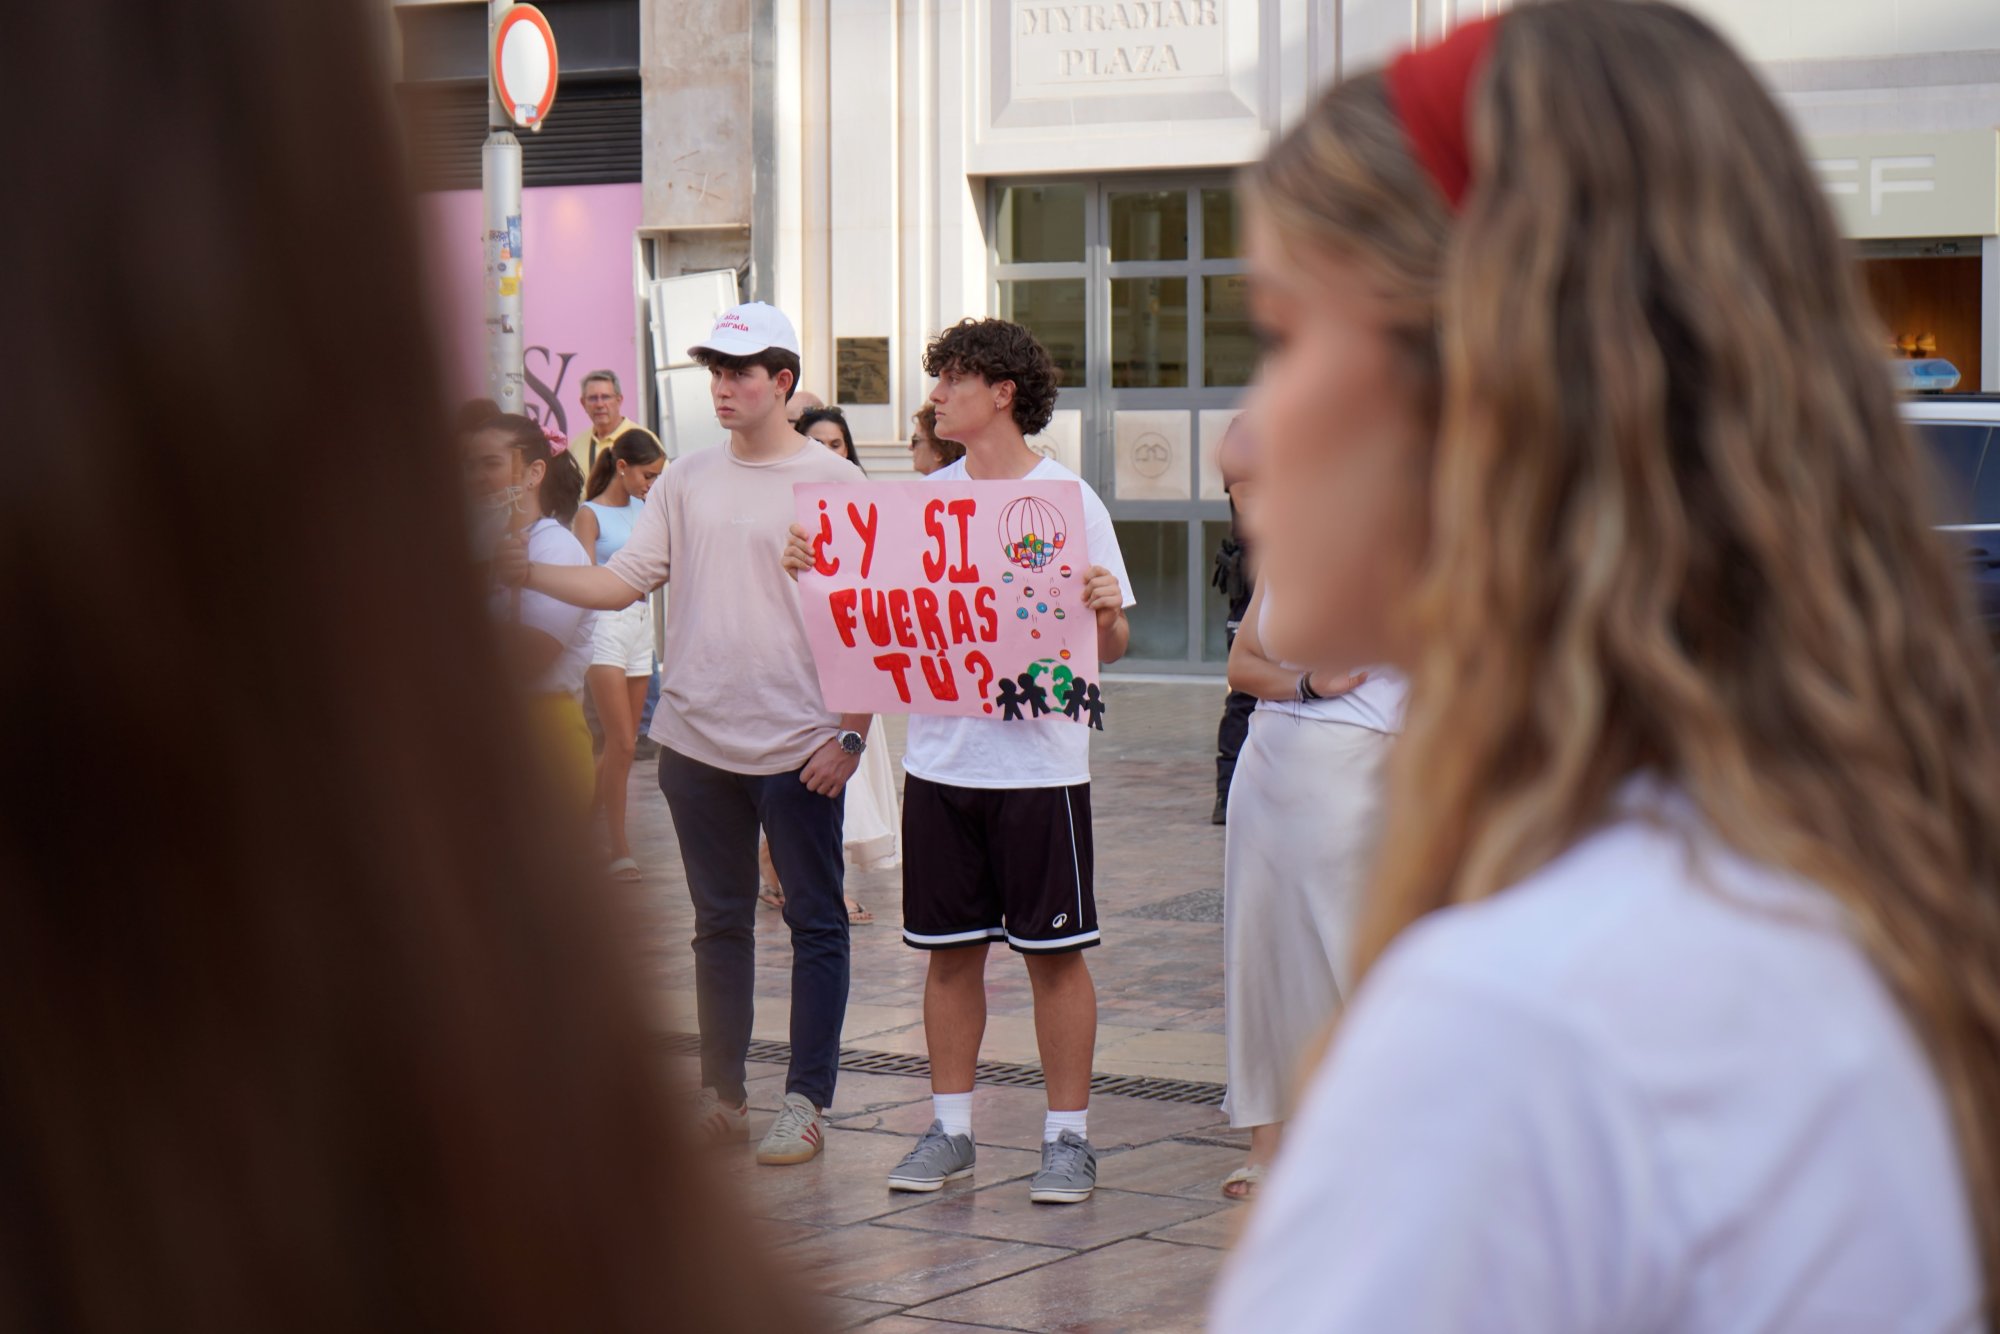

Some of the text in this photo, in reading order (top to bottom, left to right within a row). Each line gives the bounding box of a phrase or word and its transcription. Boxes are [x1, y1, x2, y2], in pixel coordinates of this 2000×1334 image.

[1021, 0, 1218, 35] MYRAMAR
[1057, 43, 1182, 77] PLAZA
[811, 498, 980, 584] ¿Y SI
[828, 586, 999, 650] FUERAS
[873, 649, 994, 714] TÚ?
